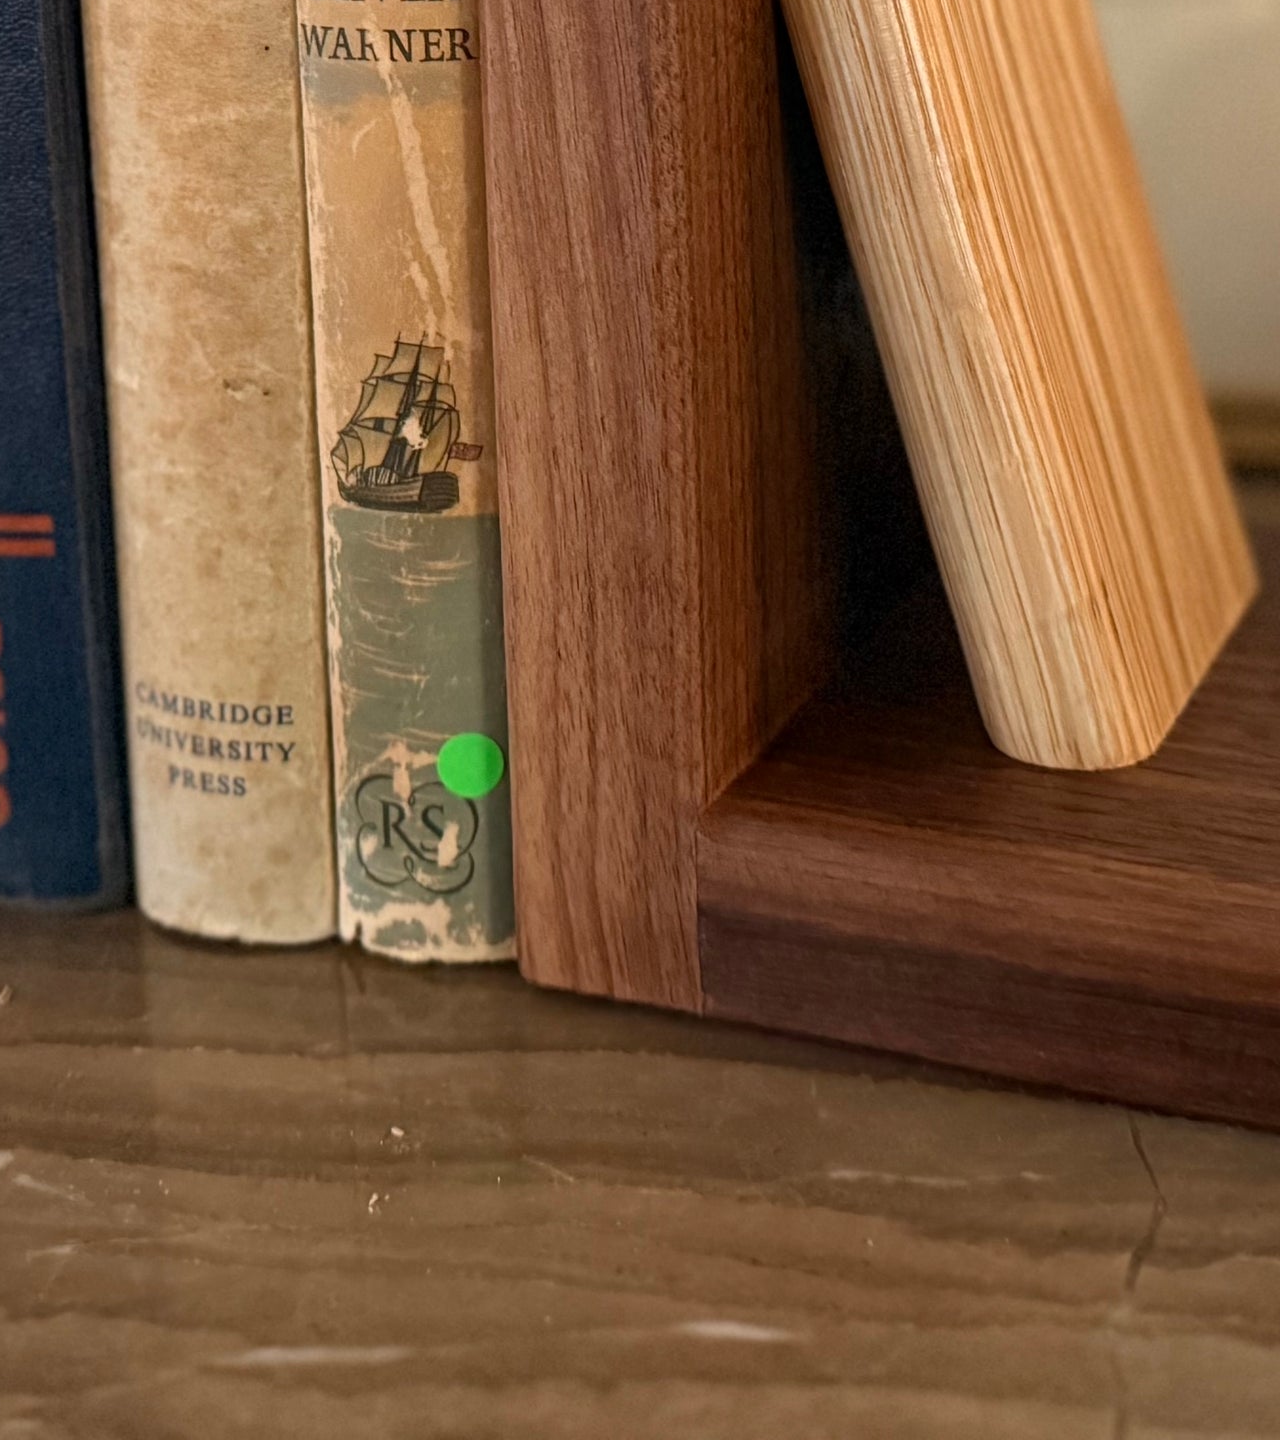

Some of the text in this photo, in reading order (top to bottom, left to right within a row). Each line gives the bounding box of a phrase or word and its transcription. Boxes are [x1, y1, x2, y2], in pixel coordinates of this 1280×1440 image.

[300, 23, 480, 63] WARNER
[136, 681, 295, 726] CAMBRIDGE
[137, 715, 297, 763] UNIVERSITY
[167, 764, 247, 797] PRESS
